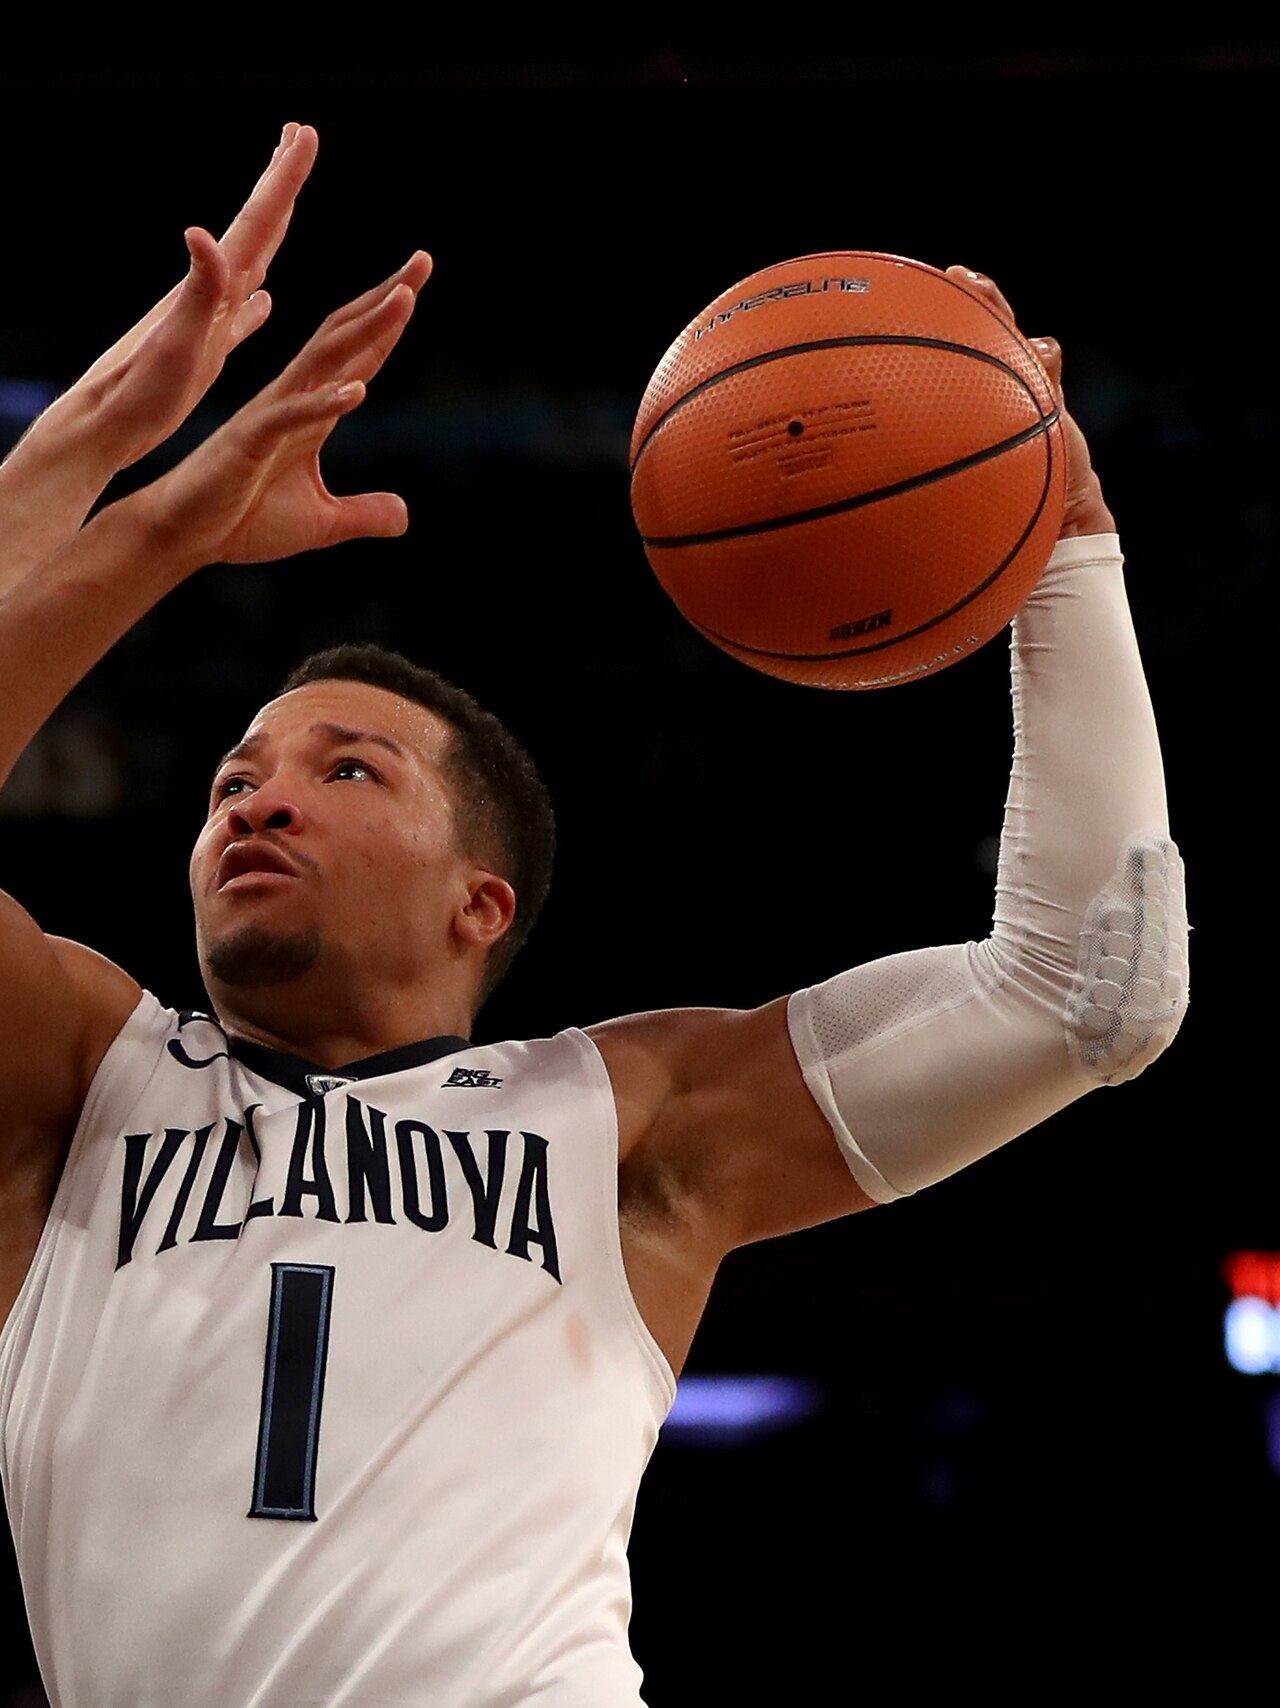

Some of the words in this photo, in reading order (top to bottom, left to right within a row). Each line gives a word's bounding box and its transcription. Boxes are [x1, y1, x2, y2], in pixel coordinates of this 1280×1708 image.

[447, 1075, 504, 1087] EAST
[450, 1067, 491, 1079] BIG
[115, 1095, 562, 1285] VILLANOVA
[246, 1262, 335, 1521] 1
